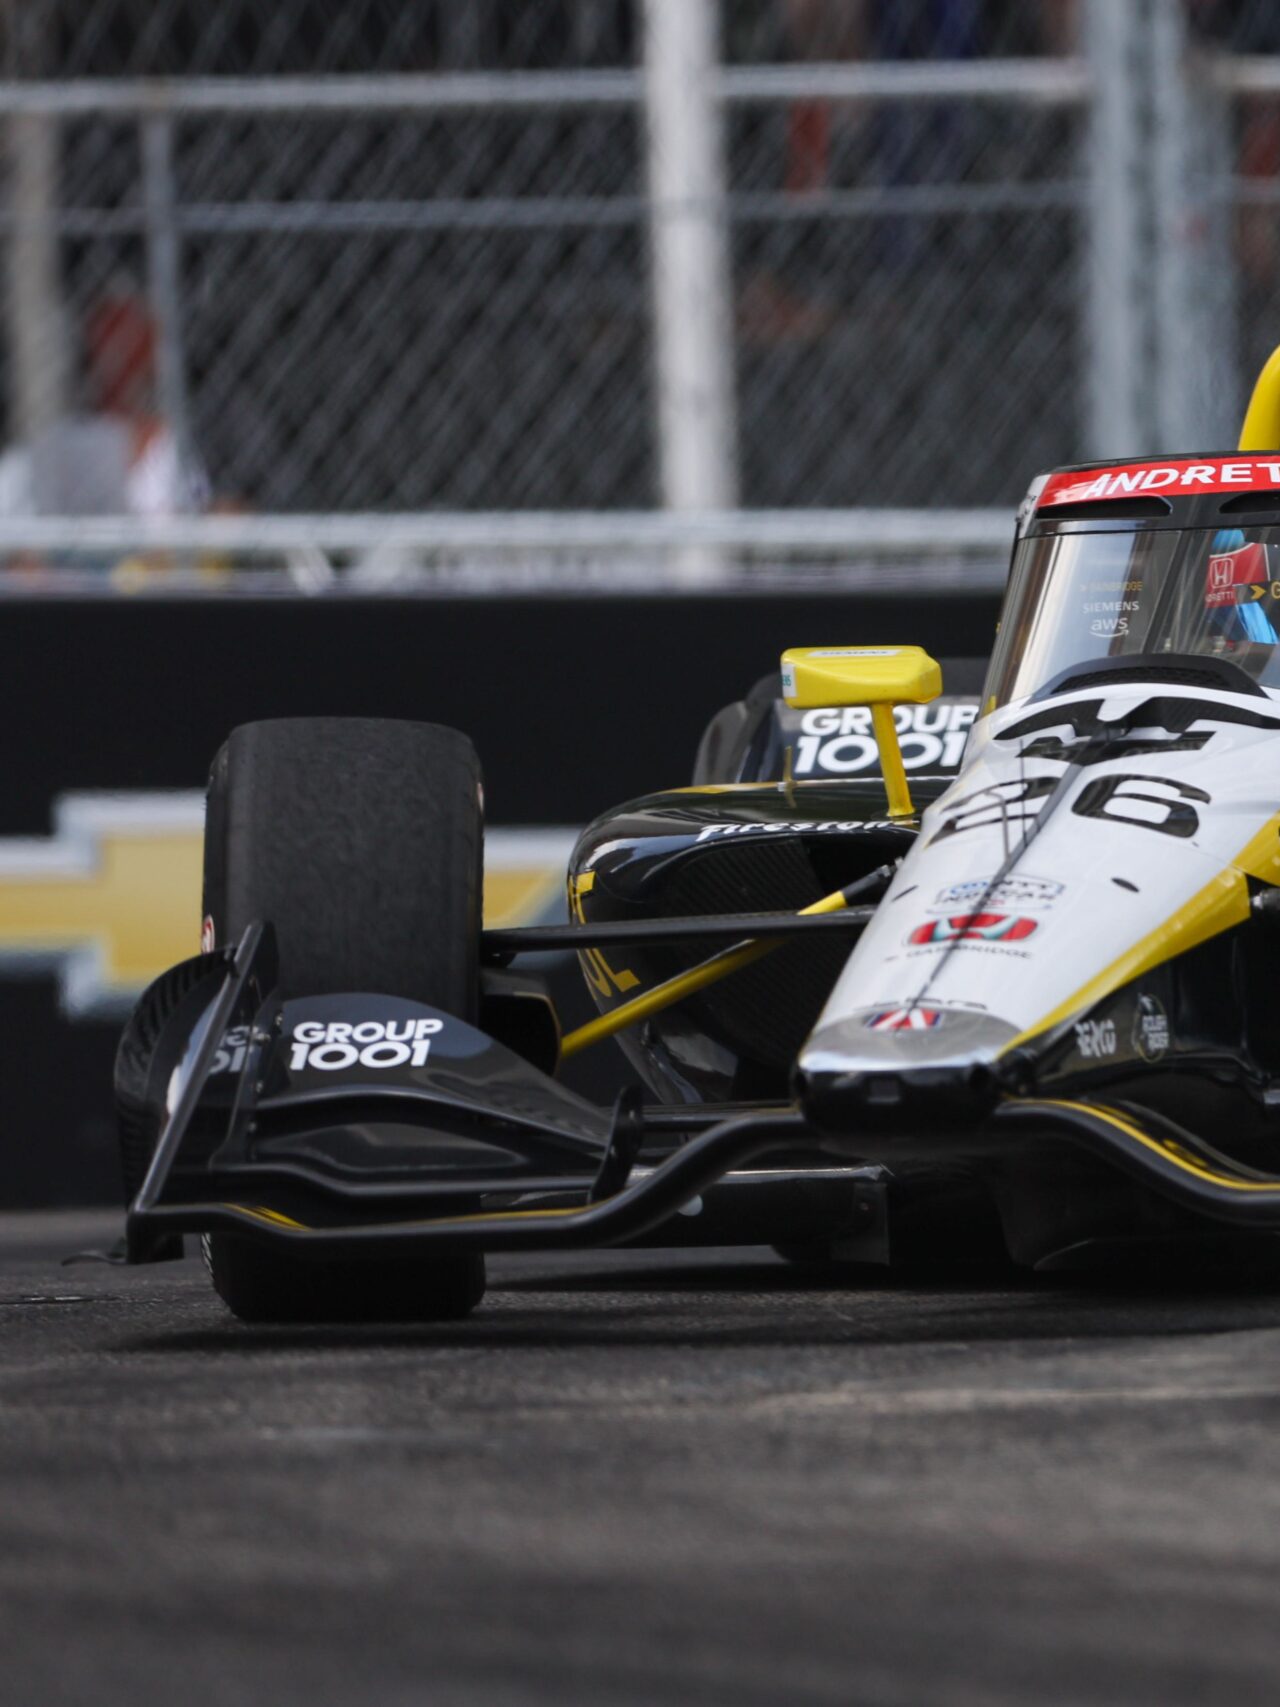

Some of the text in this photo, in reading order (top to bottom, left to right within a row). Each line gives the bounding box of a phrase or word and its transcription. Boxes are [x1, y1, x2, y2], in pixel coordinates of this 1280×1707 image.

[1082, 600, 1140, 614] SIEMENS
[1090, 617, 1129, 632] aws
[794, 731, 968, 774] 1001
[924, 773, 1212, 849] 26
[293, 1018, 444, 1045] GROUP
[289, 1038, 431, 1072] 1001
